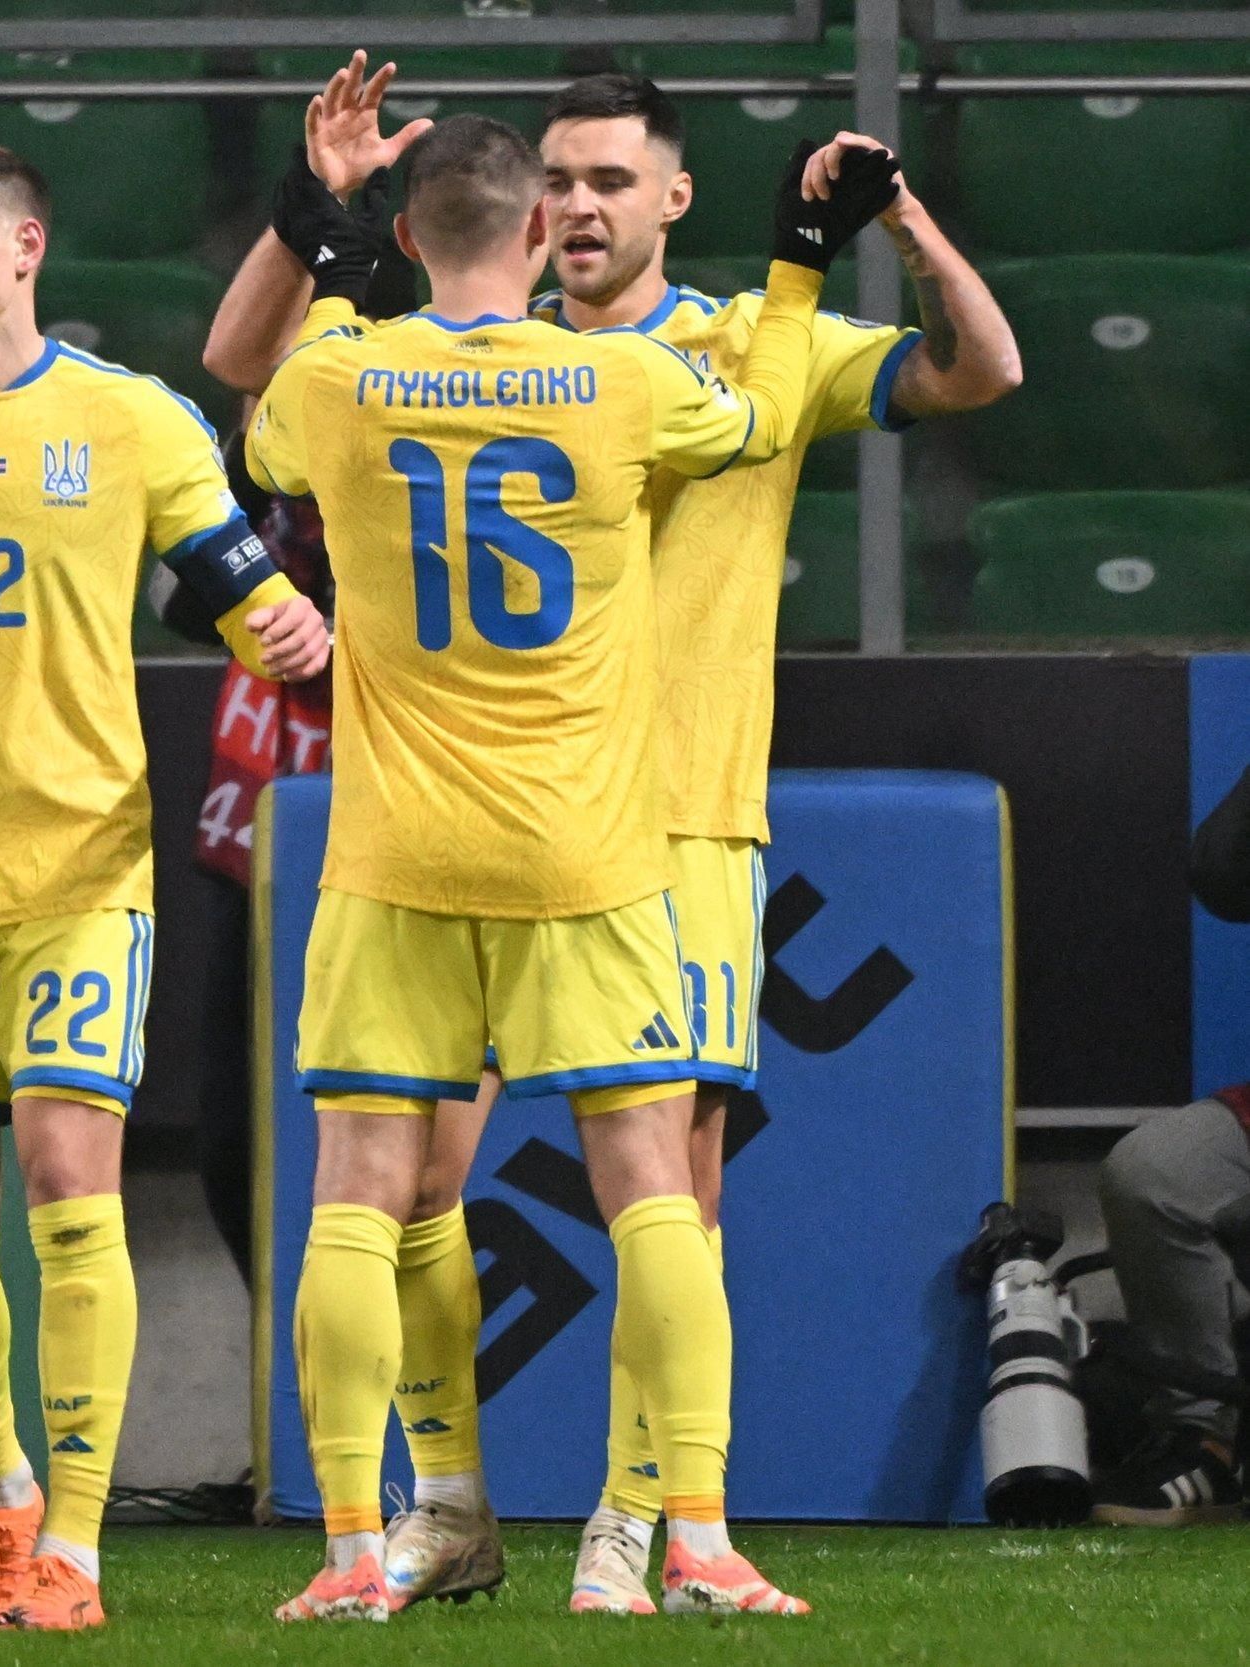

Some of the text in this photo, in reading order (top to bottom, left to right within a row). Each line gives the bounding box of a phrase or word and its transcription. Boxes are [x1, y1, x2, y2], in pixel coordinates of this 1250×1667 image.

[356, 365, 597, 408] MYKOLENKO
[388, 436, 577, 652] 16
[25, 969, 111, 1058] 22
[682, 961, 735, 1050] 11
